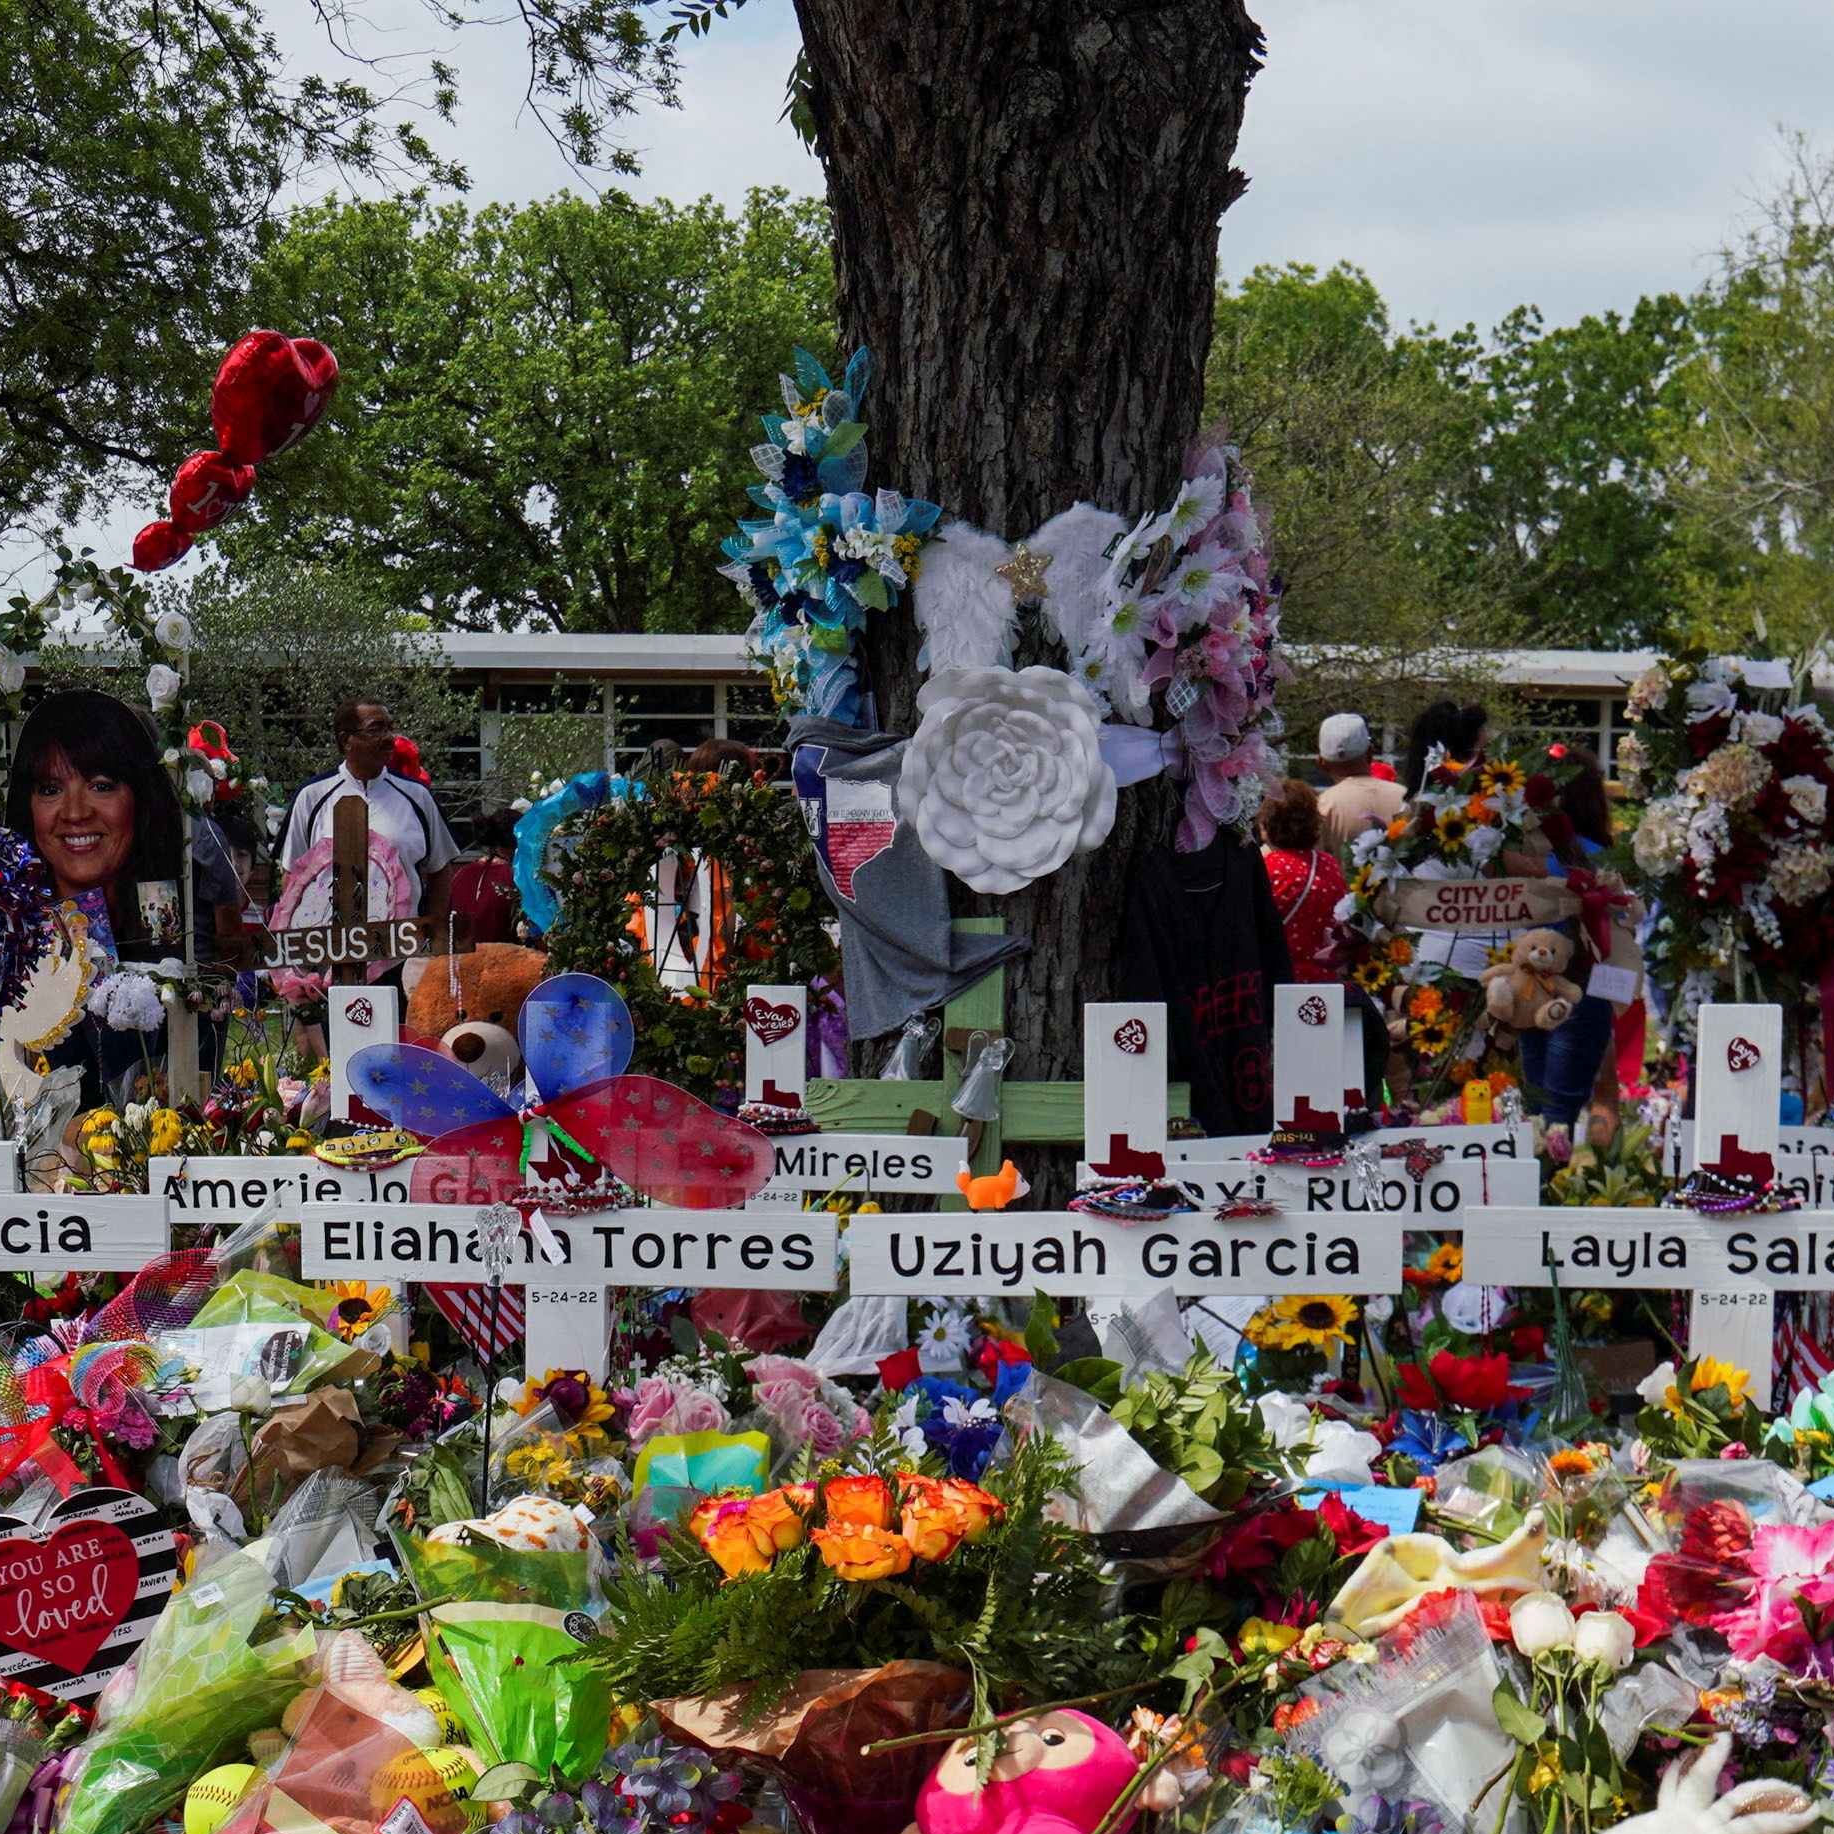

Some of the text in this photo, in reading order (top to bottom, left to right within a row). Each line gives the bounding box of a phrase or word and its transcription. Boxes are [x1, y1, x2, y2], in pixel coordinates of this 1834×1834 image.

[1437, 884, 1525, 904] CITY OF
[1426, 902, 1533, 924] COTULLA
[264, 921, 418, 968] JESUS IS
[754, 1008, 783, 1021] Eva
[775, 1145, 934, 1180] Mireles
[165, 1172, 409, 1209] Amerie Jo
[593, 1225, 815, 1270] Torres
[890, 1230, 1361, 1286] Uziyah Garcia
[1541, 1230, 1688, 1276] Layla
[531, 1291, 599, 1304] 5-24-22
[1700, 1292, 1768, 1305] 5-24-22
[55, 1538, 104, 1569] ARE
[5, 1562, 115, 1639] loved
[41, 1574, 76, 1600] SO
[112, 1625, 132, 1638] TESS
[51, 1669, 112, 1693] MIRANDA EVA
